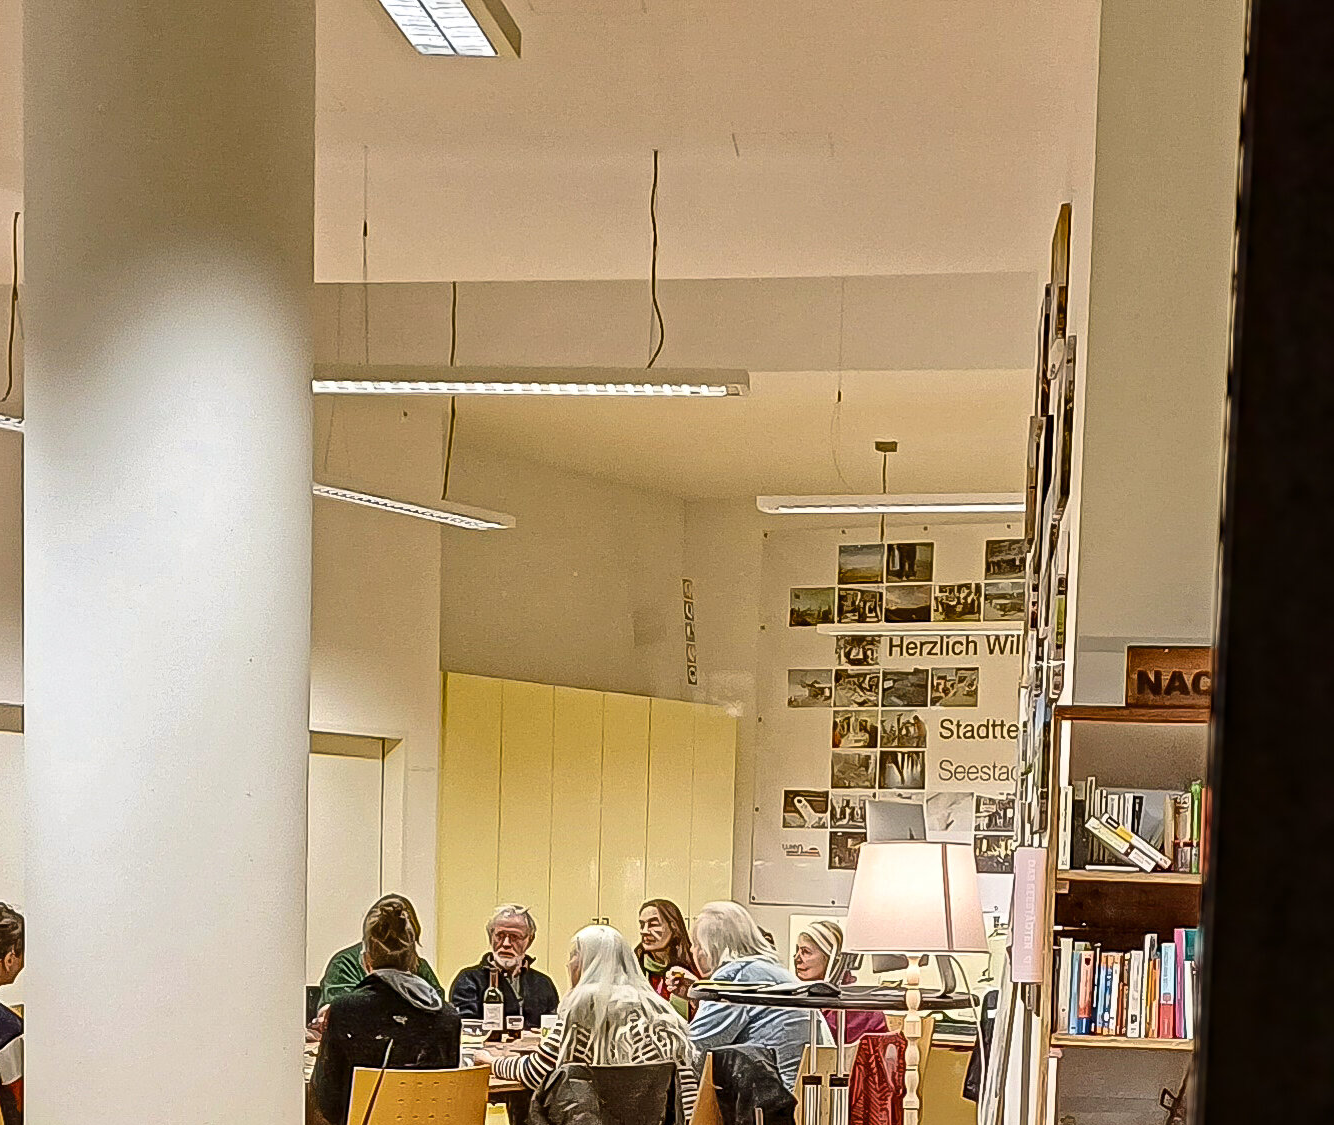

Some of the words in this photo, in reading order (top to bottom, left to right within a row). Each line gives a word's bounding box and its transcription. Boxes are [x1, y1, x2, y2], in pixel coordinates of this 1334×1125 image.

[888, 635, 978, 657] Herzlich
[1137, 669, 1211, 696] NAC
[939, 719, 1019, 740] Stadtte
